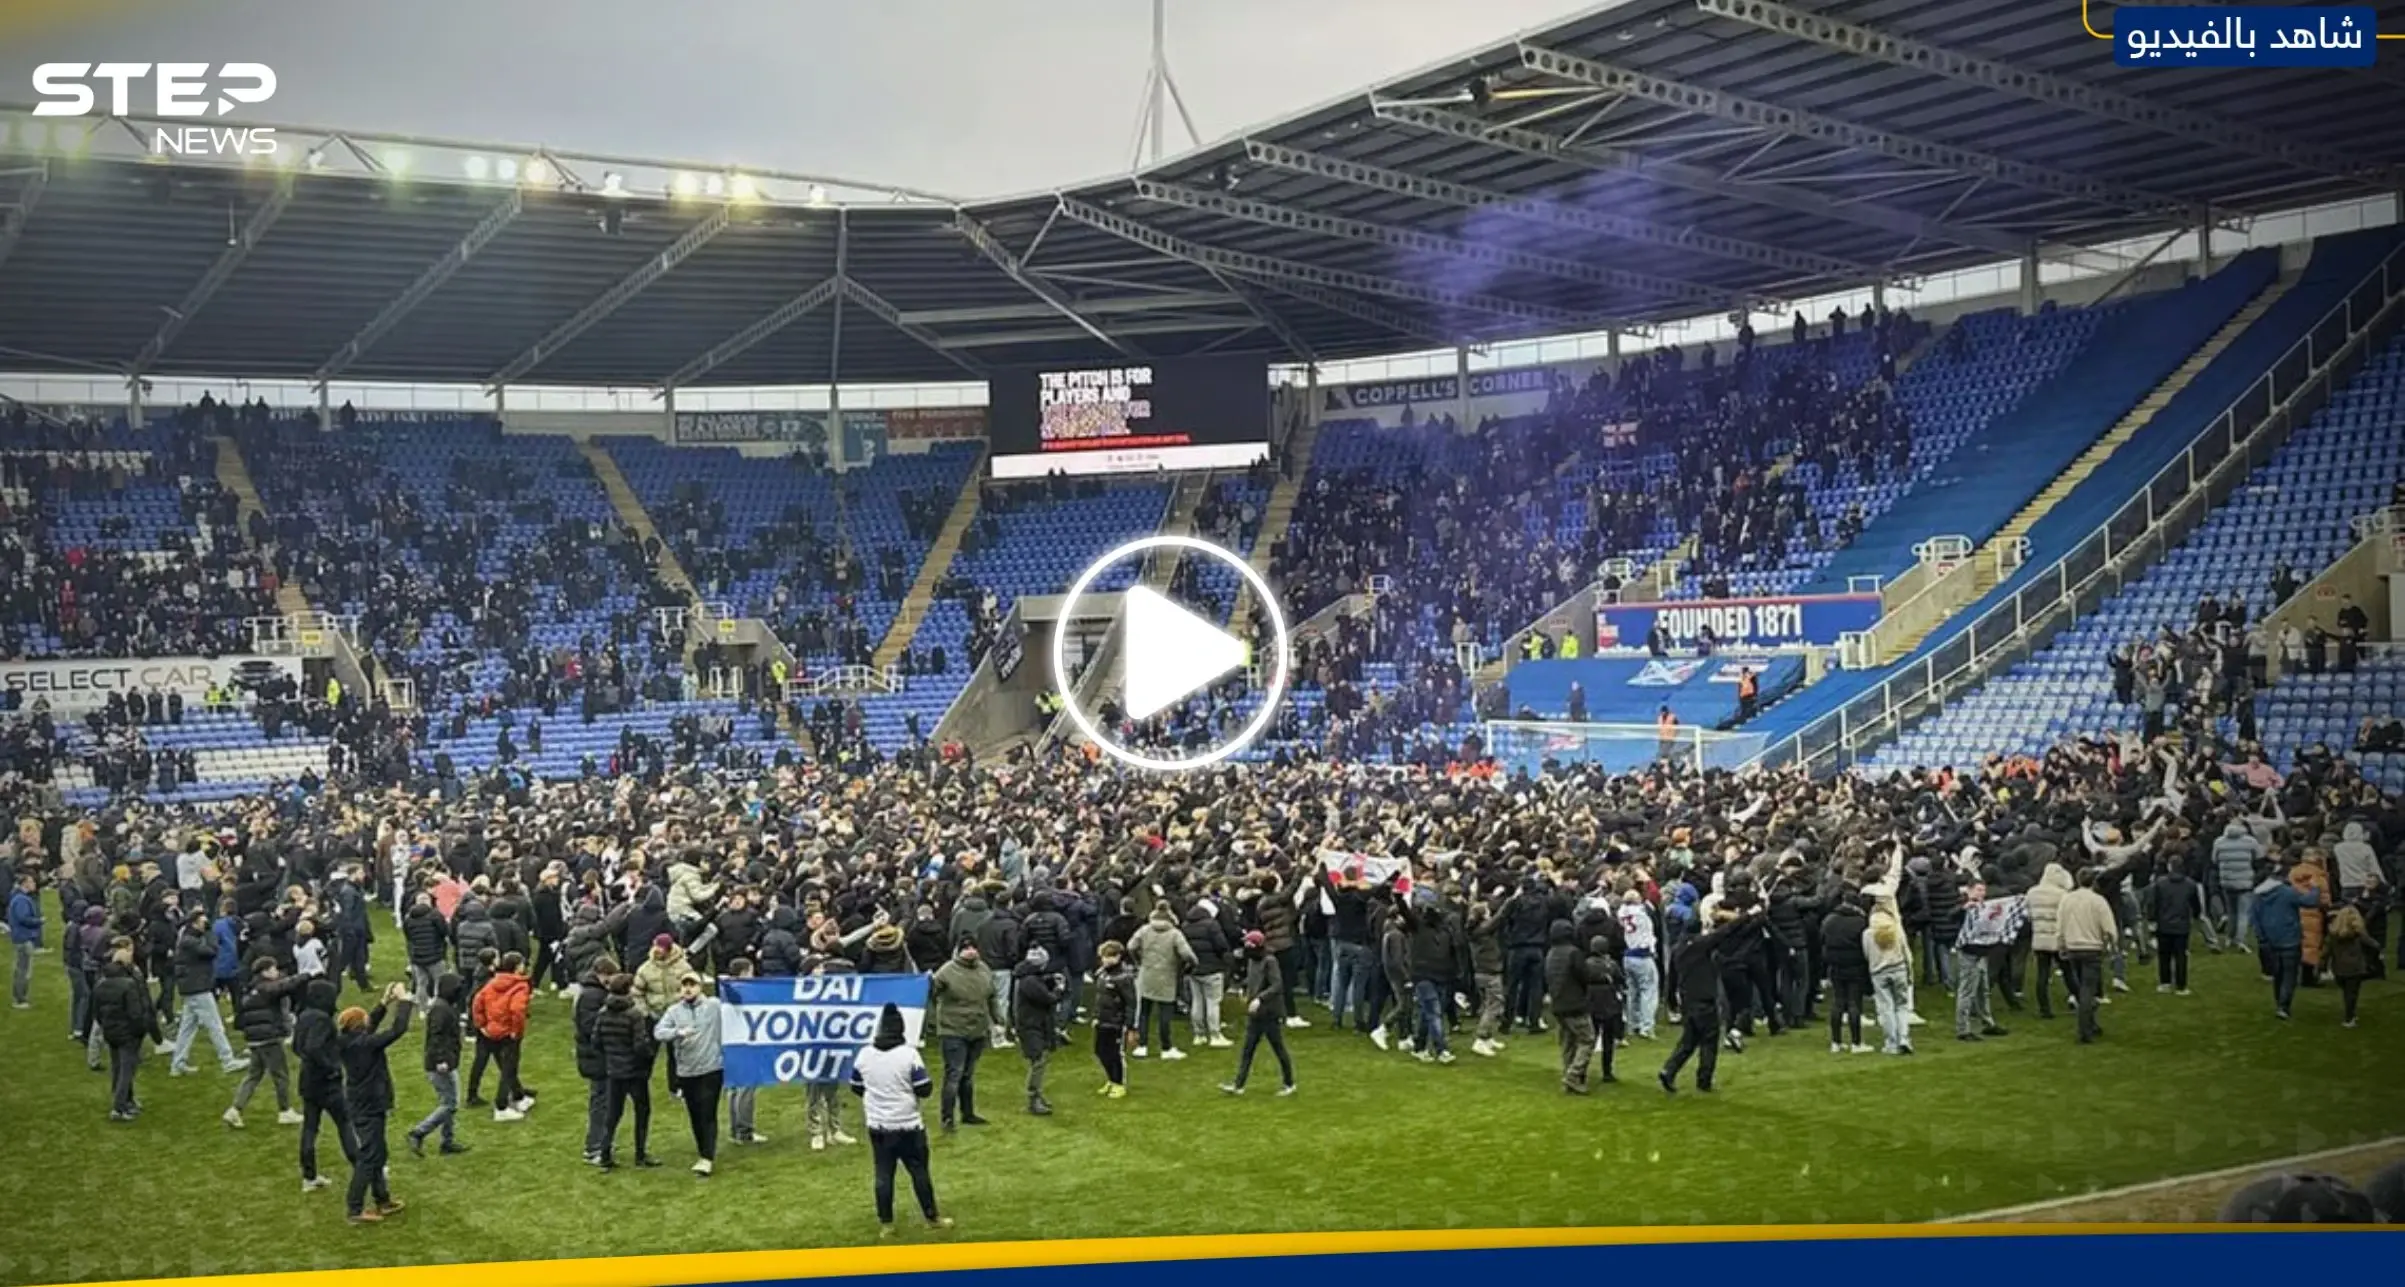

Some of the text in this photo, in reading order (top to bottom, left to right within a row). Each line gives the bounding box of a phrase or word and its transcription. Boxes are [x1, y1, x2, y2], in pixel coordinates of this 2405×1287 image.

[1041, 368, 1152, 389] THE PITCH IS FOR
[1356, 372, 1543, 404] COPPELL'S CORNER
[1041, 385, 1131, 404] PLAYERS AND
[1657, 603, 1803, 639] FOUNDED 1871
[4, 664, 213, 692] SELECT CAR
[793, 975, 864, 1001] DAI
[743, 1010, 876, 1041] YONGG
[774, 1047, 853, 1081] OUT
